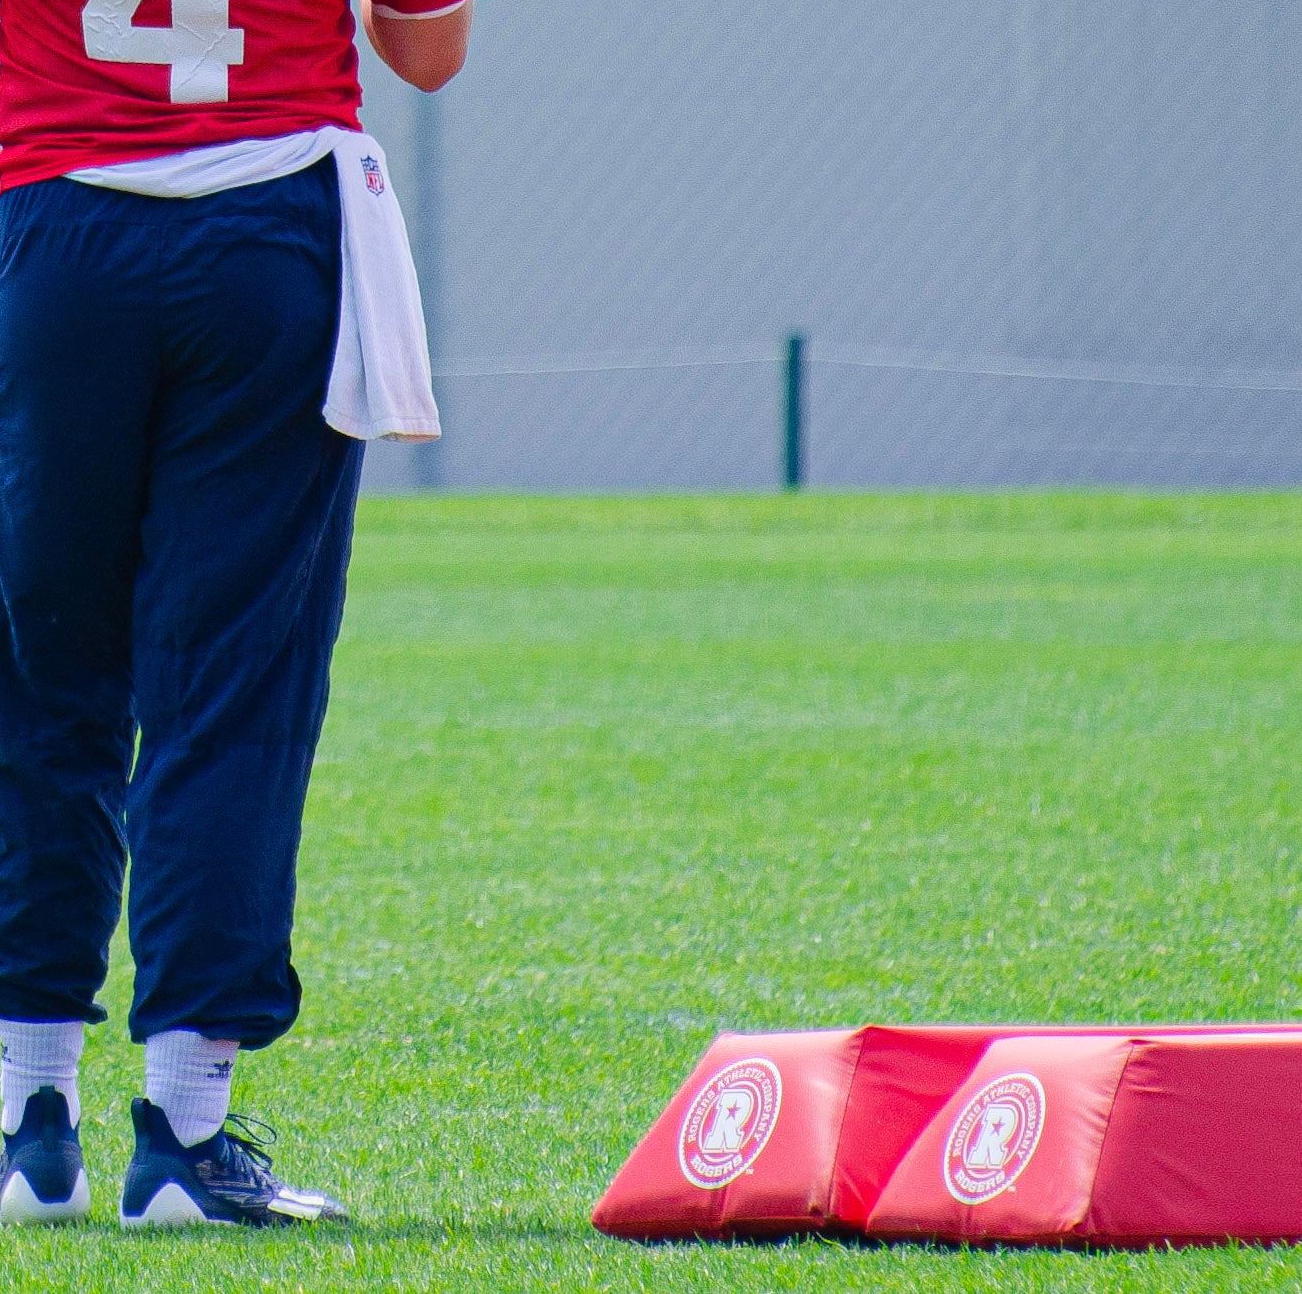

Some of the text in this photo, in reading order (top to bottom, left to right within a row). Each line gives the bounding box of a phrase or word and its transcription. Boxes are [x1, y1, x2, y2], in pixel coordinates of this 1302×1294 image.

[717, 1067, 766, 1092] ATHLETIC
[754, 1078, 773, 1142] COMPANY
[983, 1083, 1030, 1105] ATHLETIC
[702, 1088, 755, 1153] R
[966, 1104, 1019, 1169] R
[690, 1153, 743, 1177] ROGERS
[955, 1170, 1006, 1193] ROGERS
